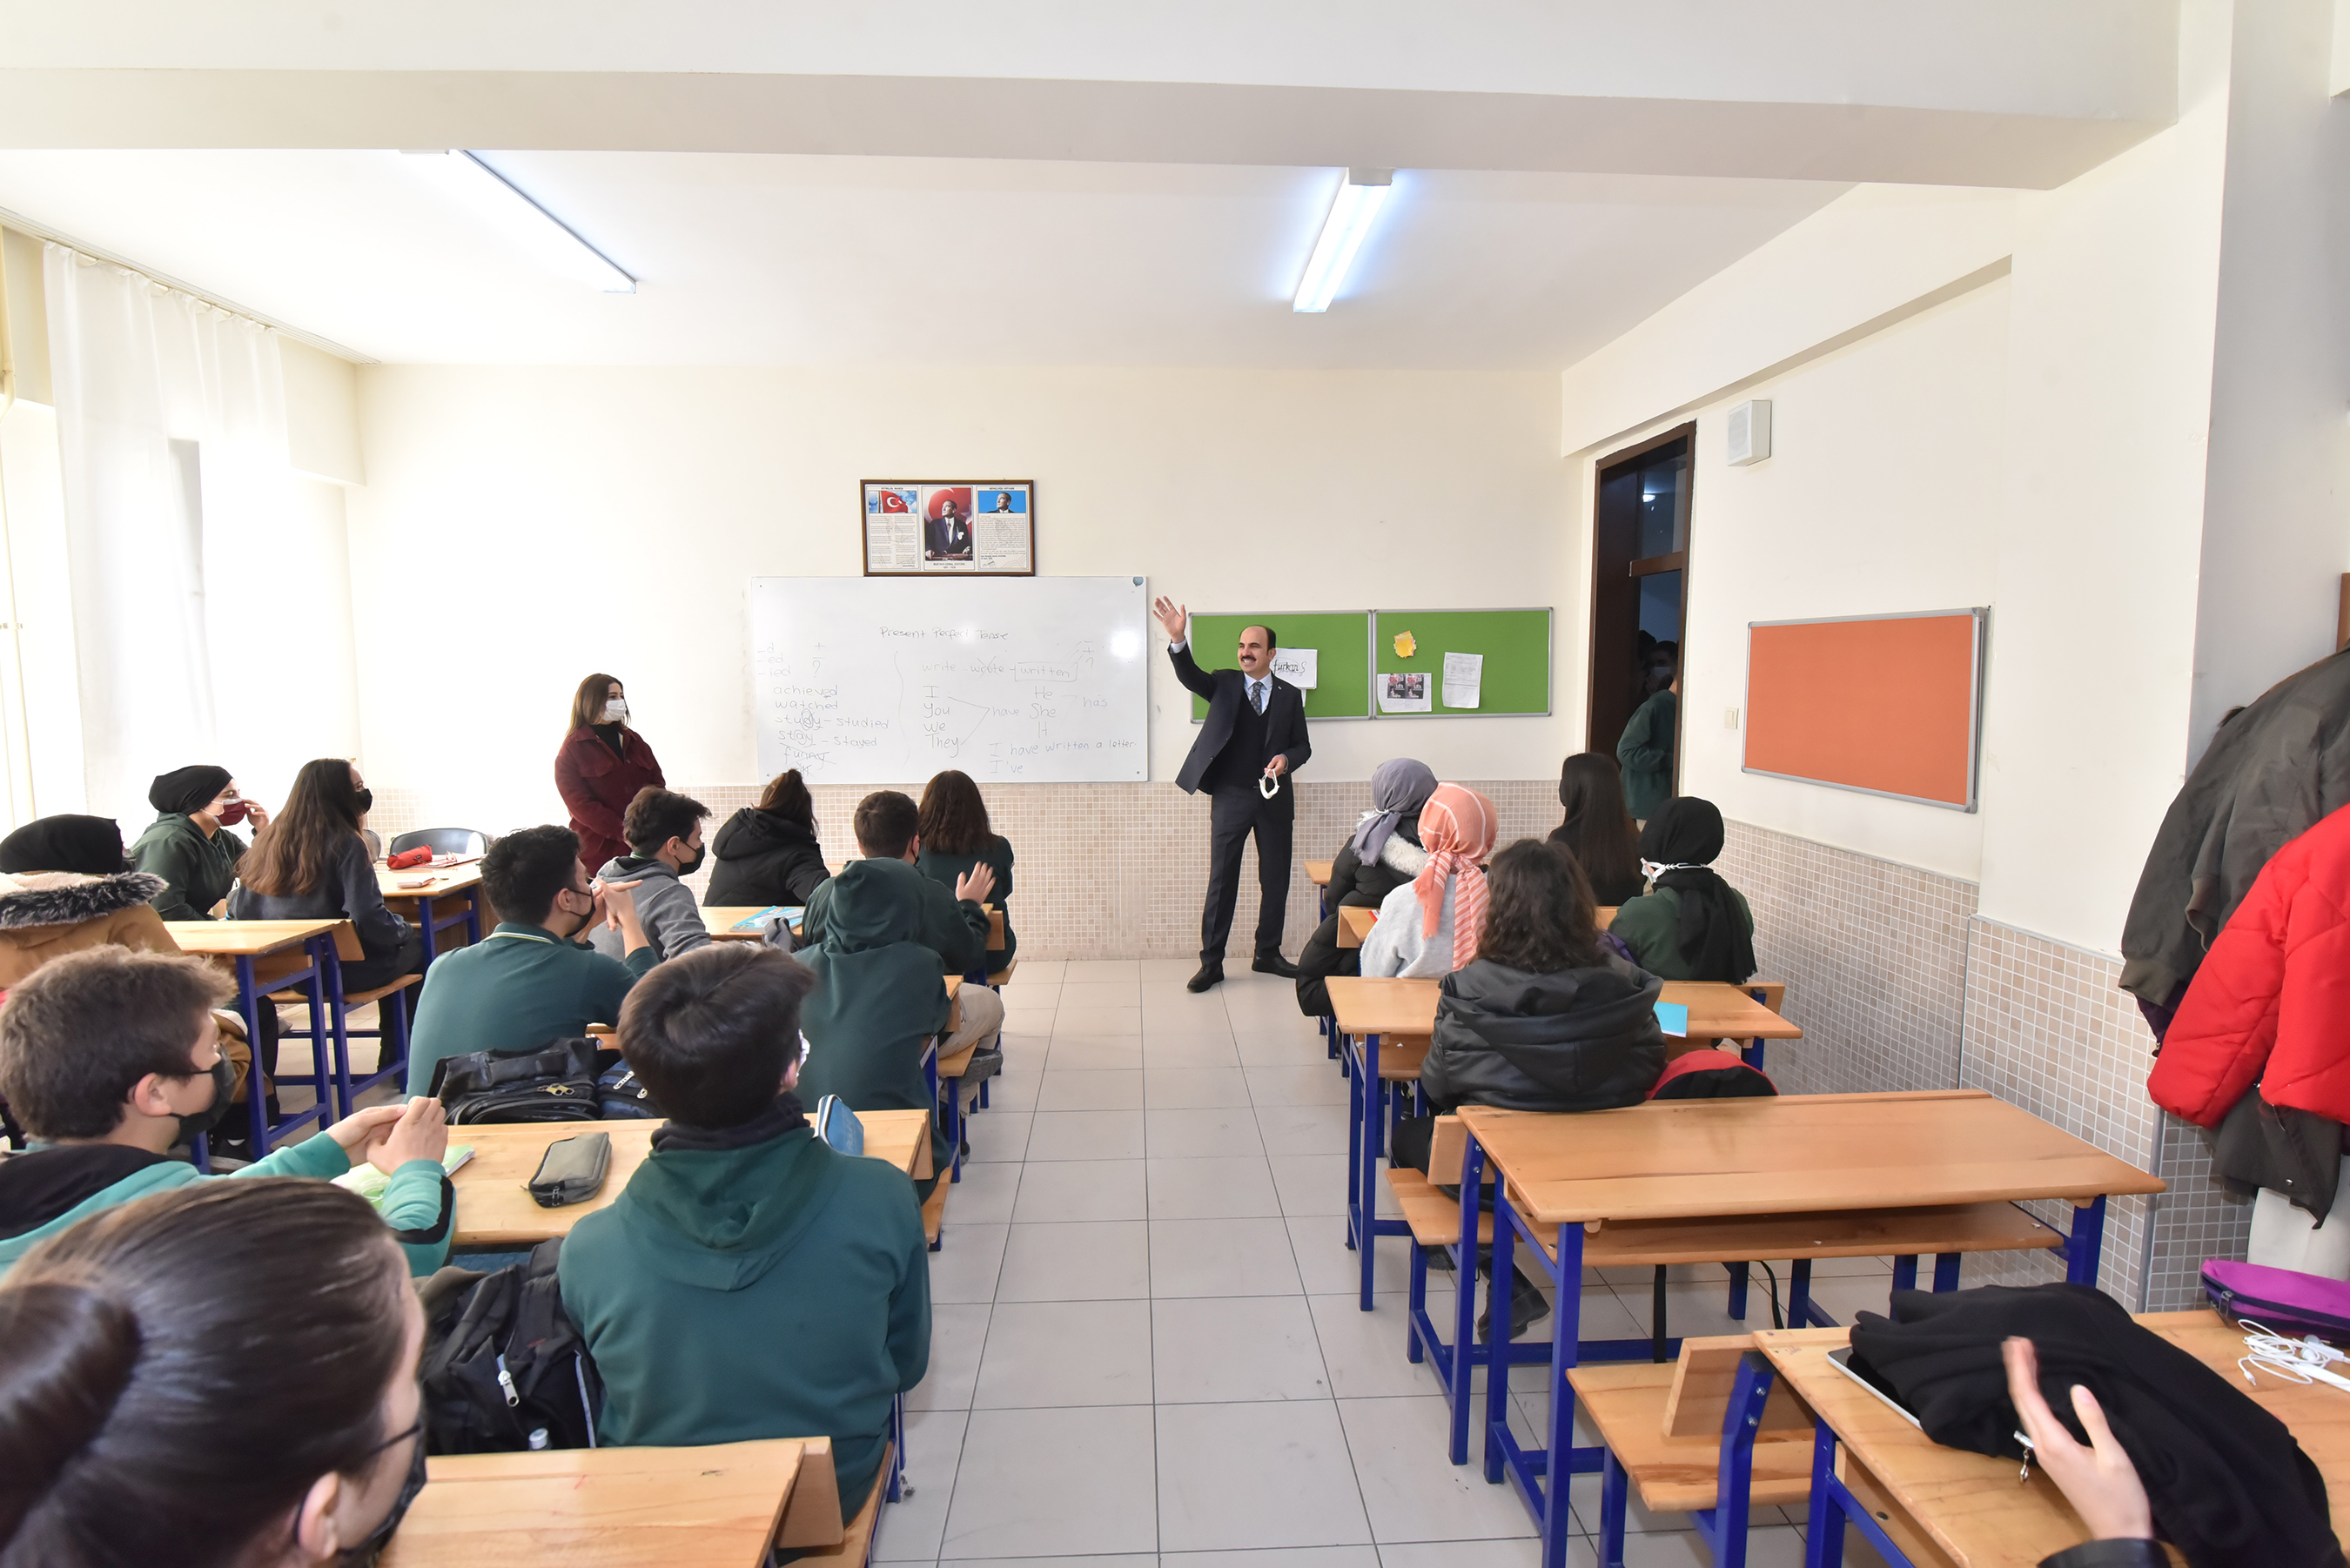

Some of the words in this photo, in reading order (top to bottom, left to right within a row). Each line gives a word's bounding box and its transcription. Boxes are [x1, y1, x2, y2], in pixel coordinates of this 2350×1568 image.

[879, 627, 926, 638] Present
[932, 627, 969, 639] Perfect
[976, 629, 1009, 640] Tense
[922, 661, 957, 673] write
[1020, 667, 1071, 679] written
[774, 685, 838, 696] achieved
[1034, 686, 1053, 700] He
[776, 700, 838, 711] watched
[1083, 696, 1108, 708] has
[992, 707, 1019, 717] have
[1030, 703, 1057, 720] She
[924, 733, 959, 759] They
[989, 742, 1003, 757] I
[1010, 743, 1039, 756] have
[1046, 741, 1089, 752] written
[989, 760, 1024, 774] I've
